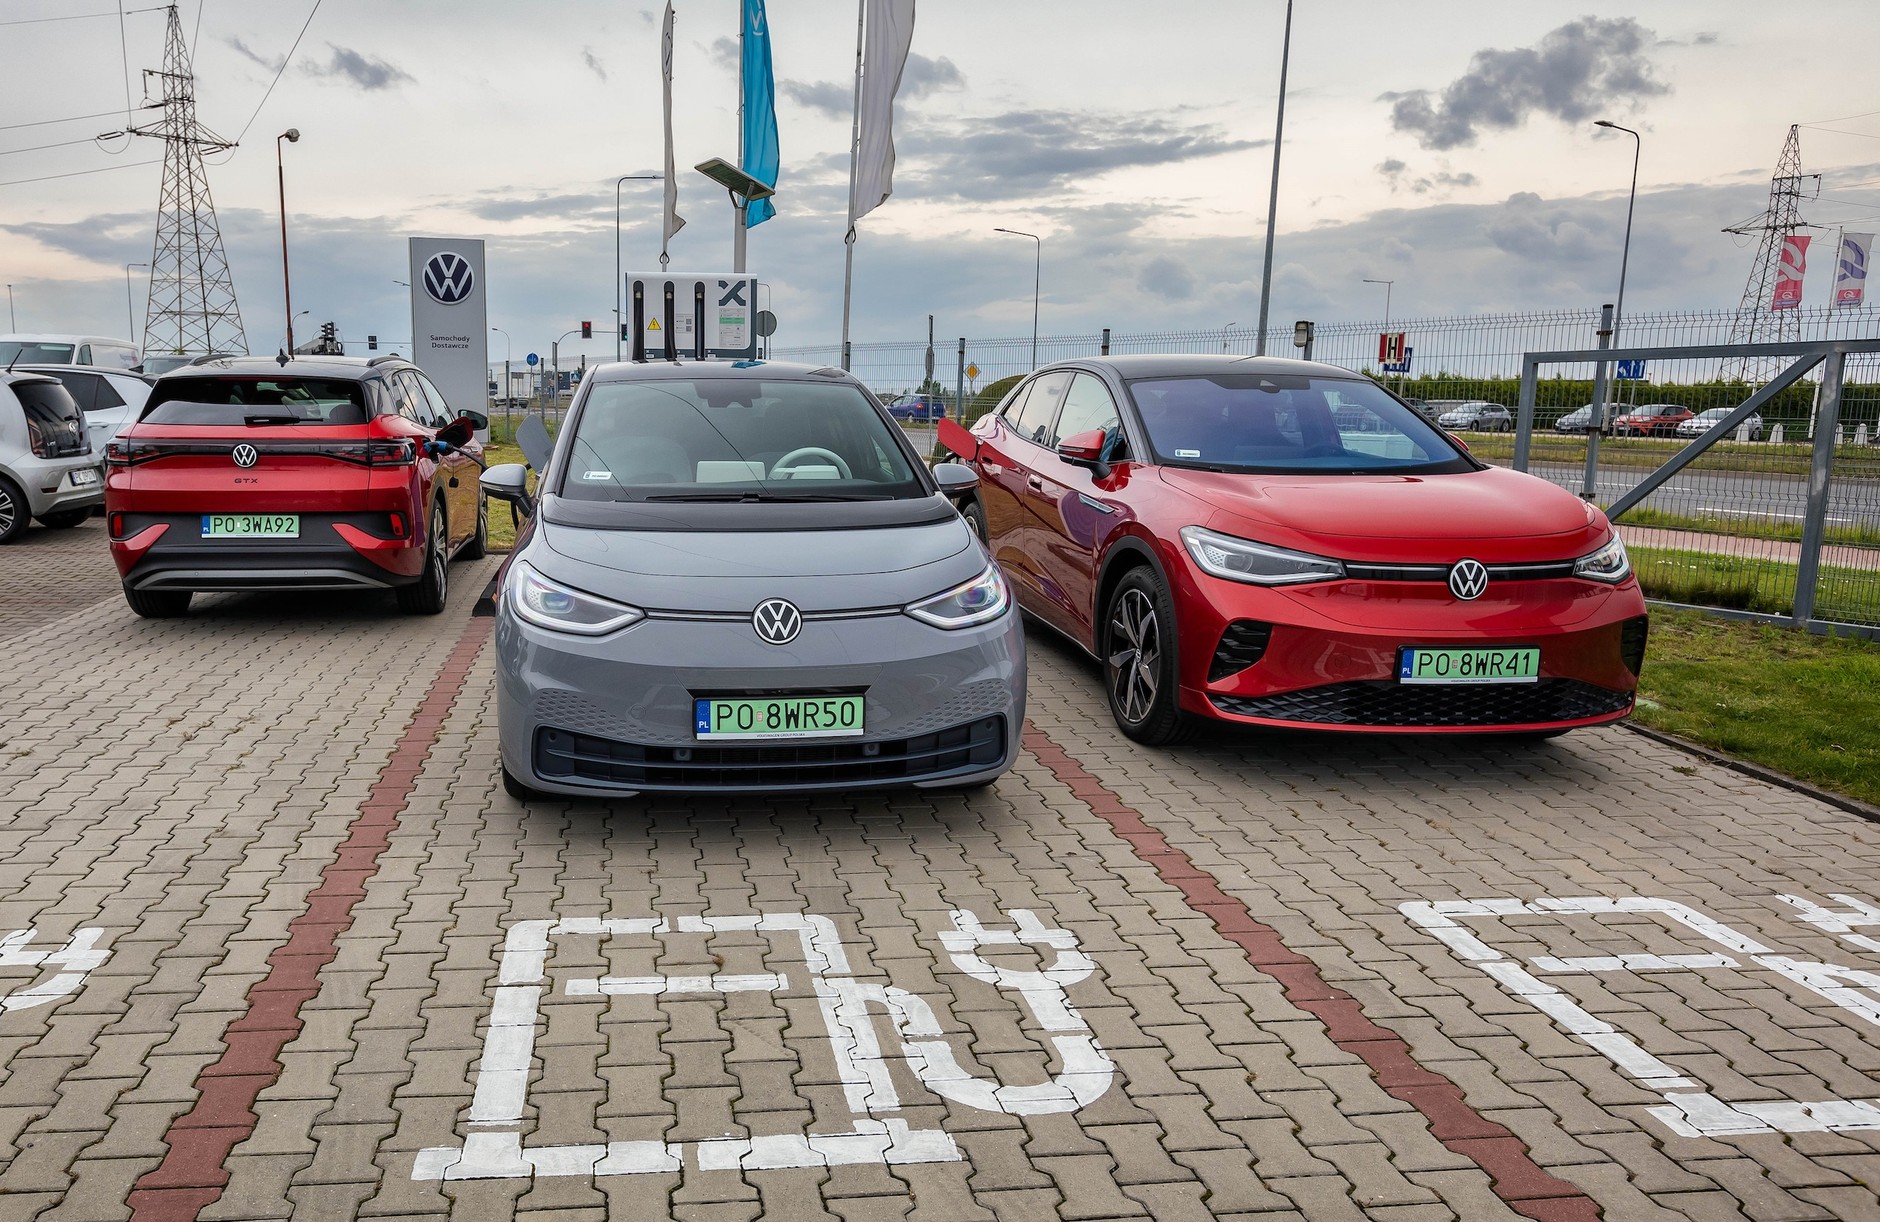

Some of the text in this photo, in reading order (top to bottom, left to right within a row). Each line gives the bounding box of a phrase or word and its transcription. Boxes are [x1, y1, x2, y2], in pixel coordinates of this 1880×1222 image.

[422, 251, 475, 305] VW
[430, 334, 471, 343] Samochody
[213, 516, 294, 533] PO 3WA92
[1418, 651, 1530, 676] PO 8WR41
[698, 721, 709, 729] PL
[716, 700, 856, 731] PO 8WR50
